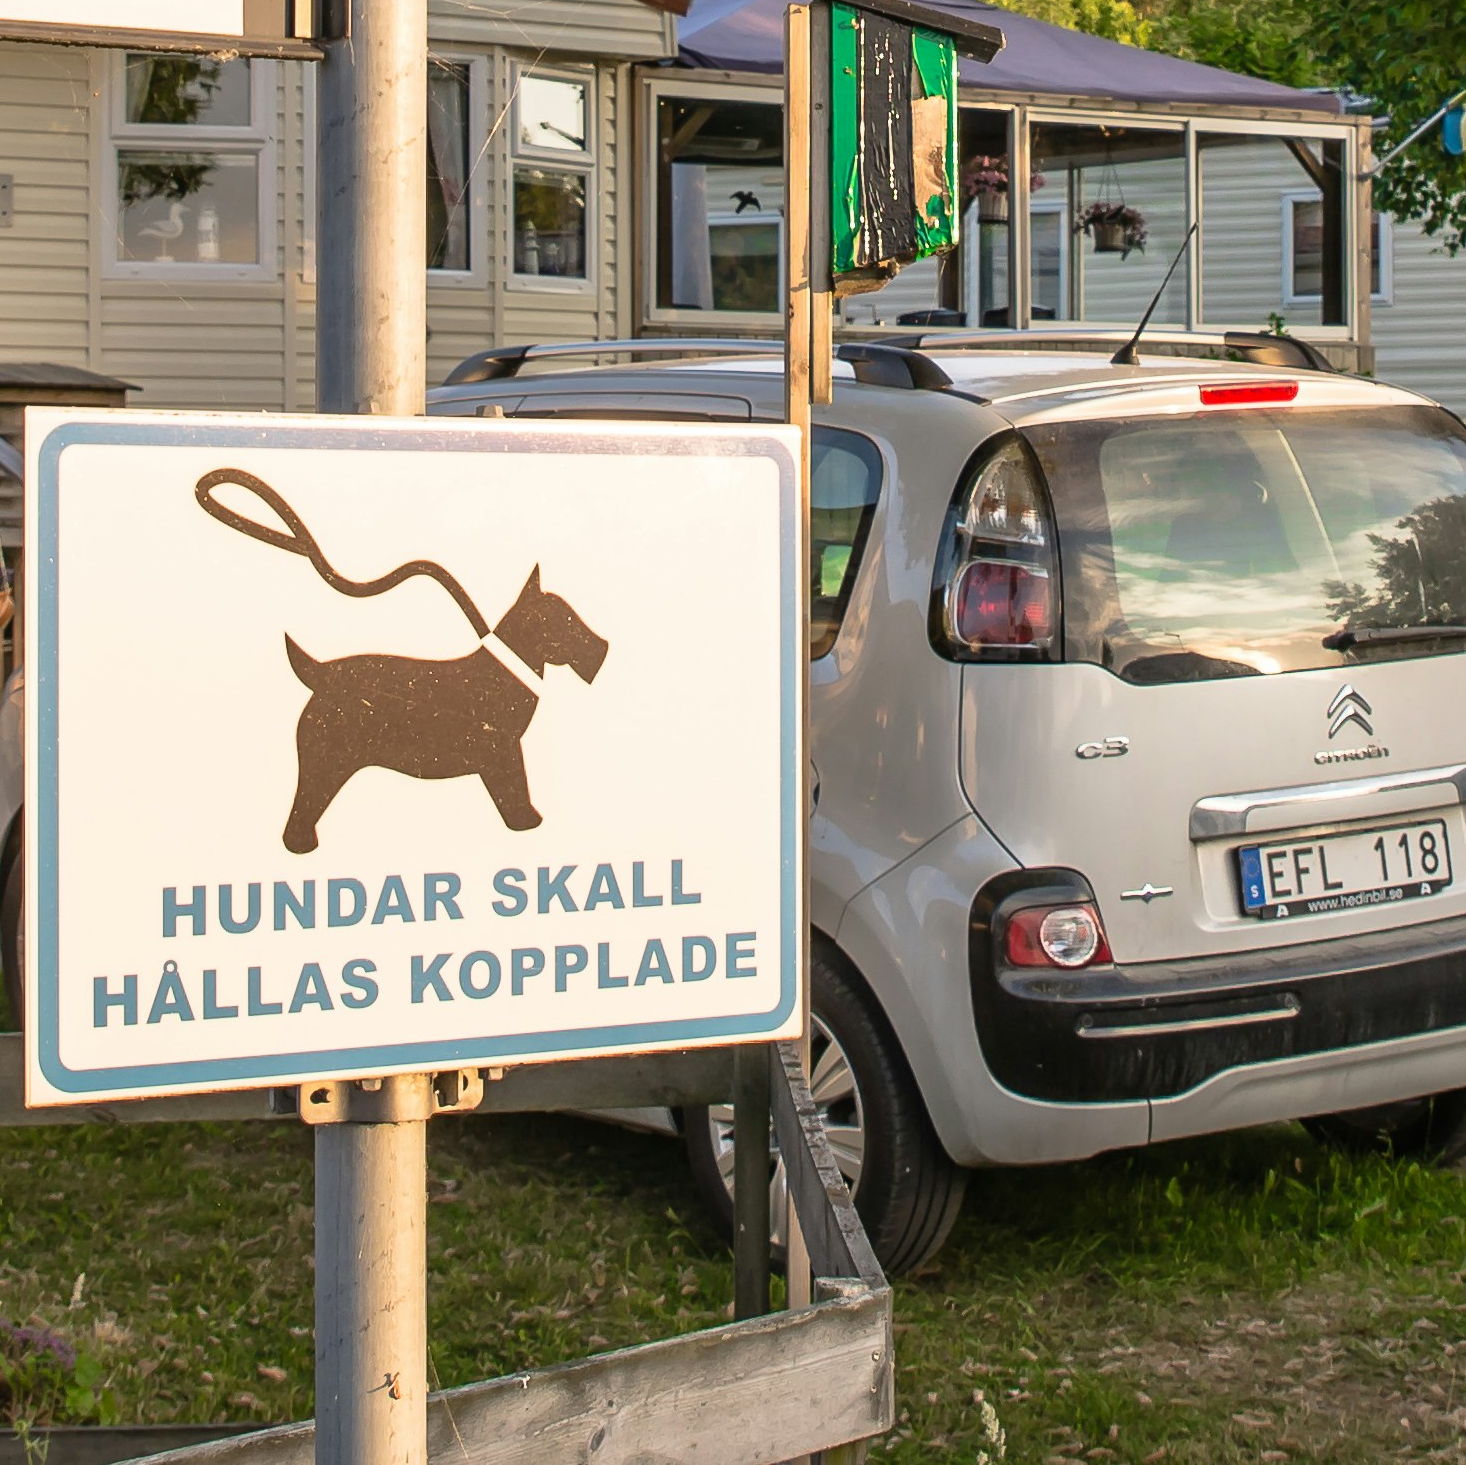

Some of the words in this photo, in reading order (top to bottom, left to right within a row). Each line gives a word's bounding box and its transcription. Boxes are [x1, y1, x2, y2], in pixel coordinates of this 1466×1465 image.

[1076, 736, 1129, 759] C3
[1266, 845, 1344, 898] EFL
[1374, 831, 1439, 881] 118
[162, 872, 465, 938] HUNDAR
[491, 858, 702, 918] SKALL
[1250, 885, 1260, 899] S
[1308, 888, 1403, 912] www.hedinbil.se
[93, 958, 379, 1029] HÅLLAS
[410, 931, 758, 1004] KOPPLADE
